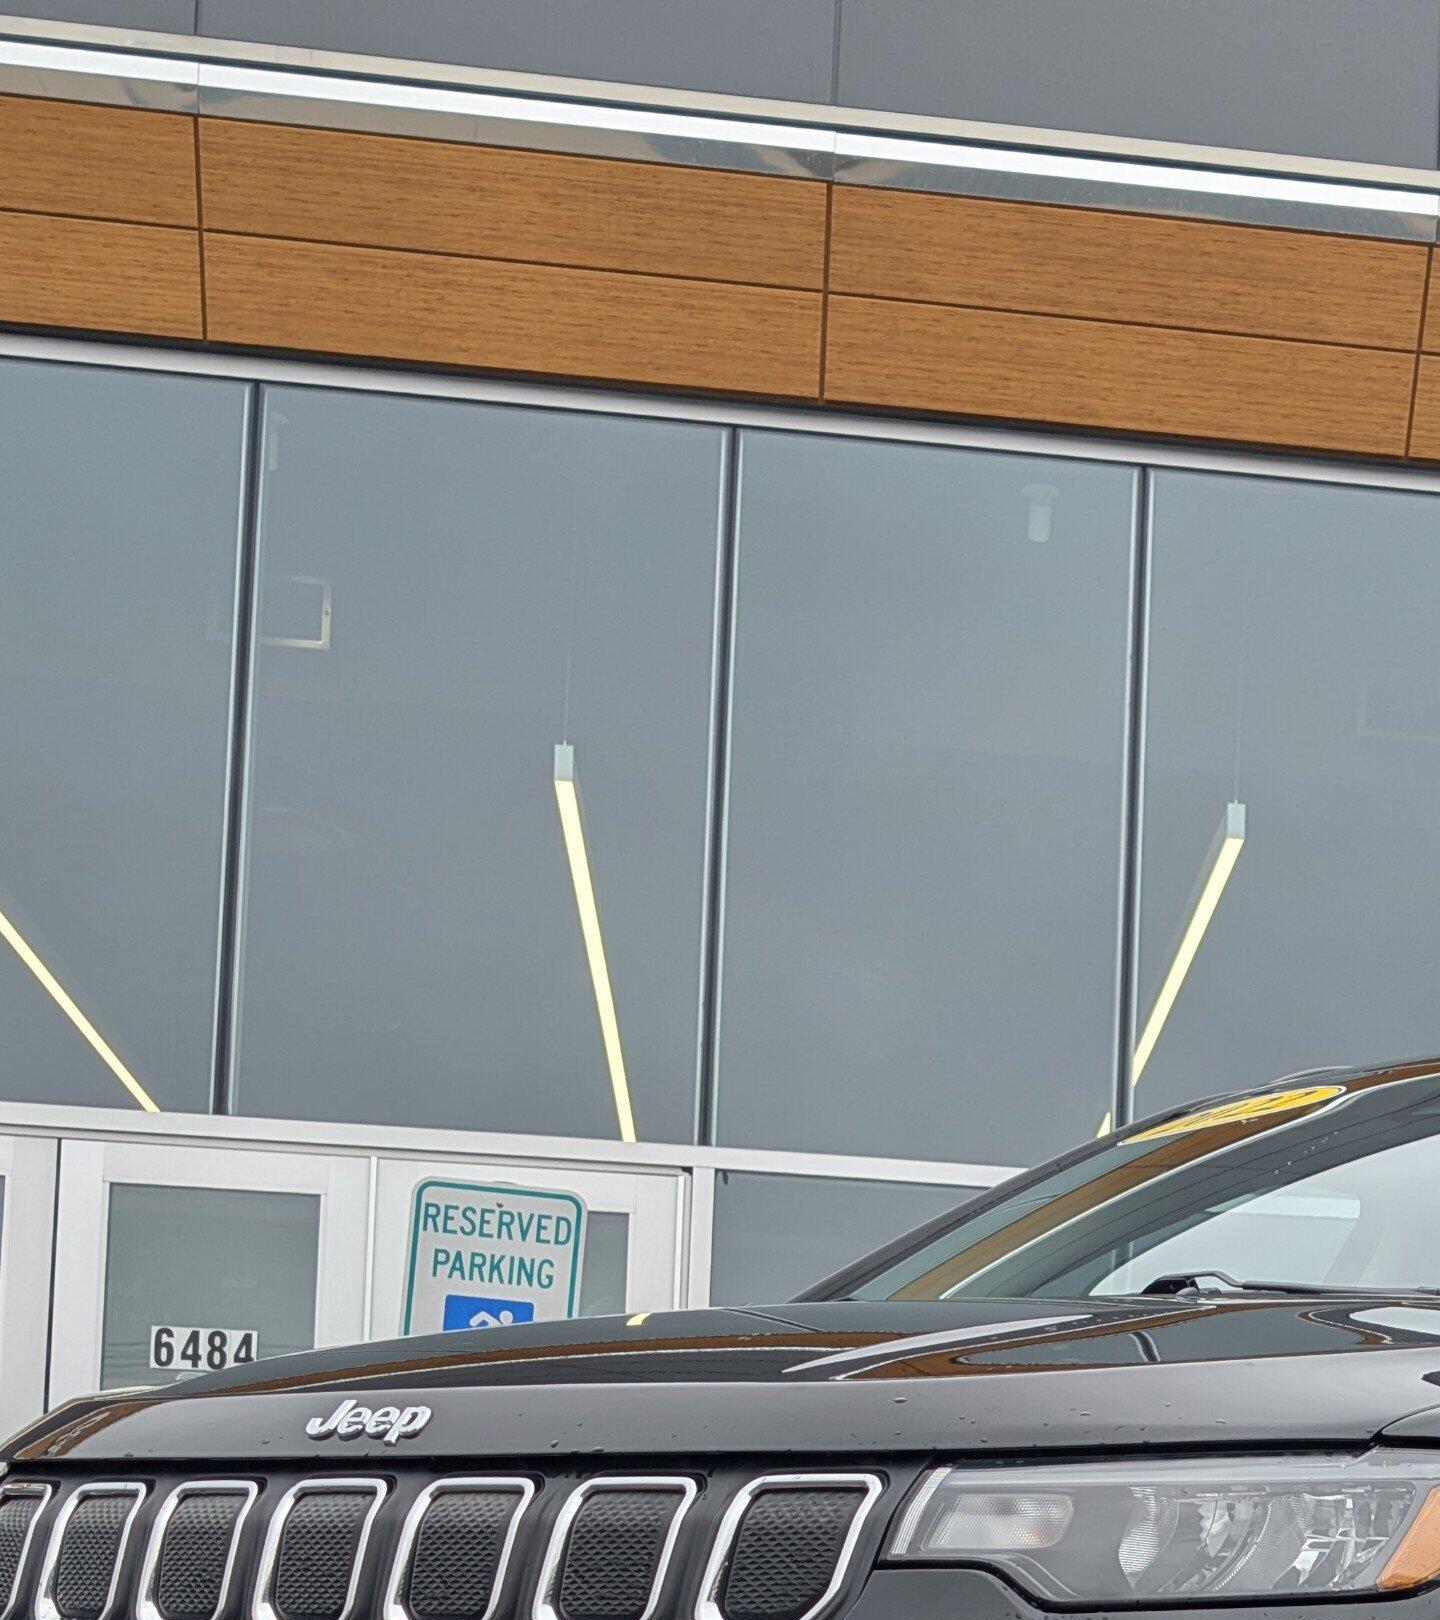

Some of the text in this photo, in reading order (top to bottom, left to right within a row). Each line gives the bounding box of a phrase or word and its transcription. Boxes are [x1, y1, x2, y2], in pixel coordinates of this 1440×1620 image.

[421, 1202, 573, 1246] RESERVED
[432, 1248, 556, 1290] PARKING
[153, 1327, 255, 1369] 6484
[306, 1399, 433, 1446] Jeep
